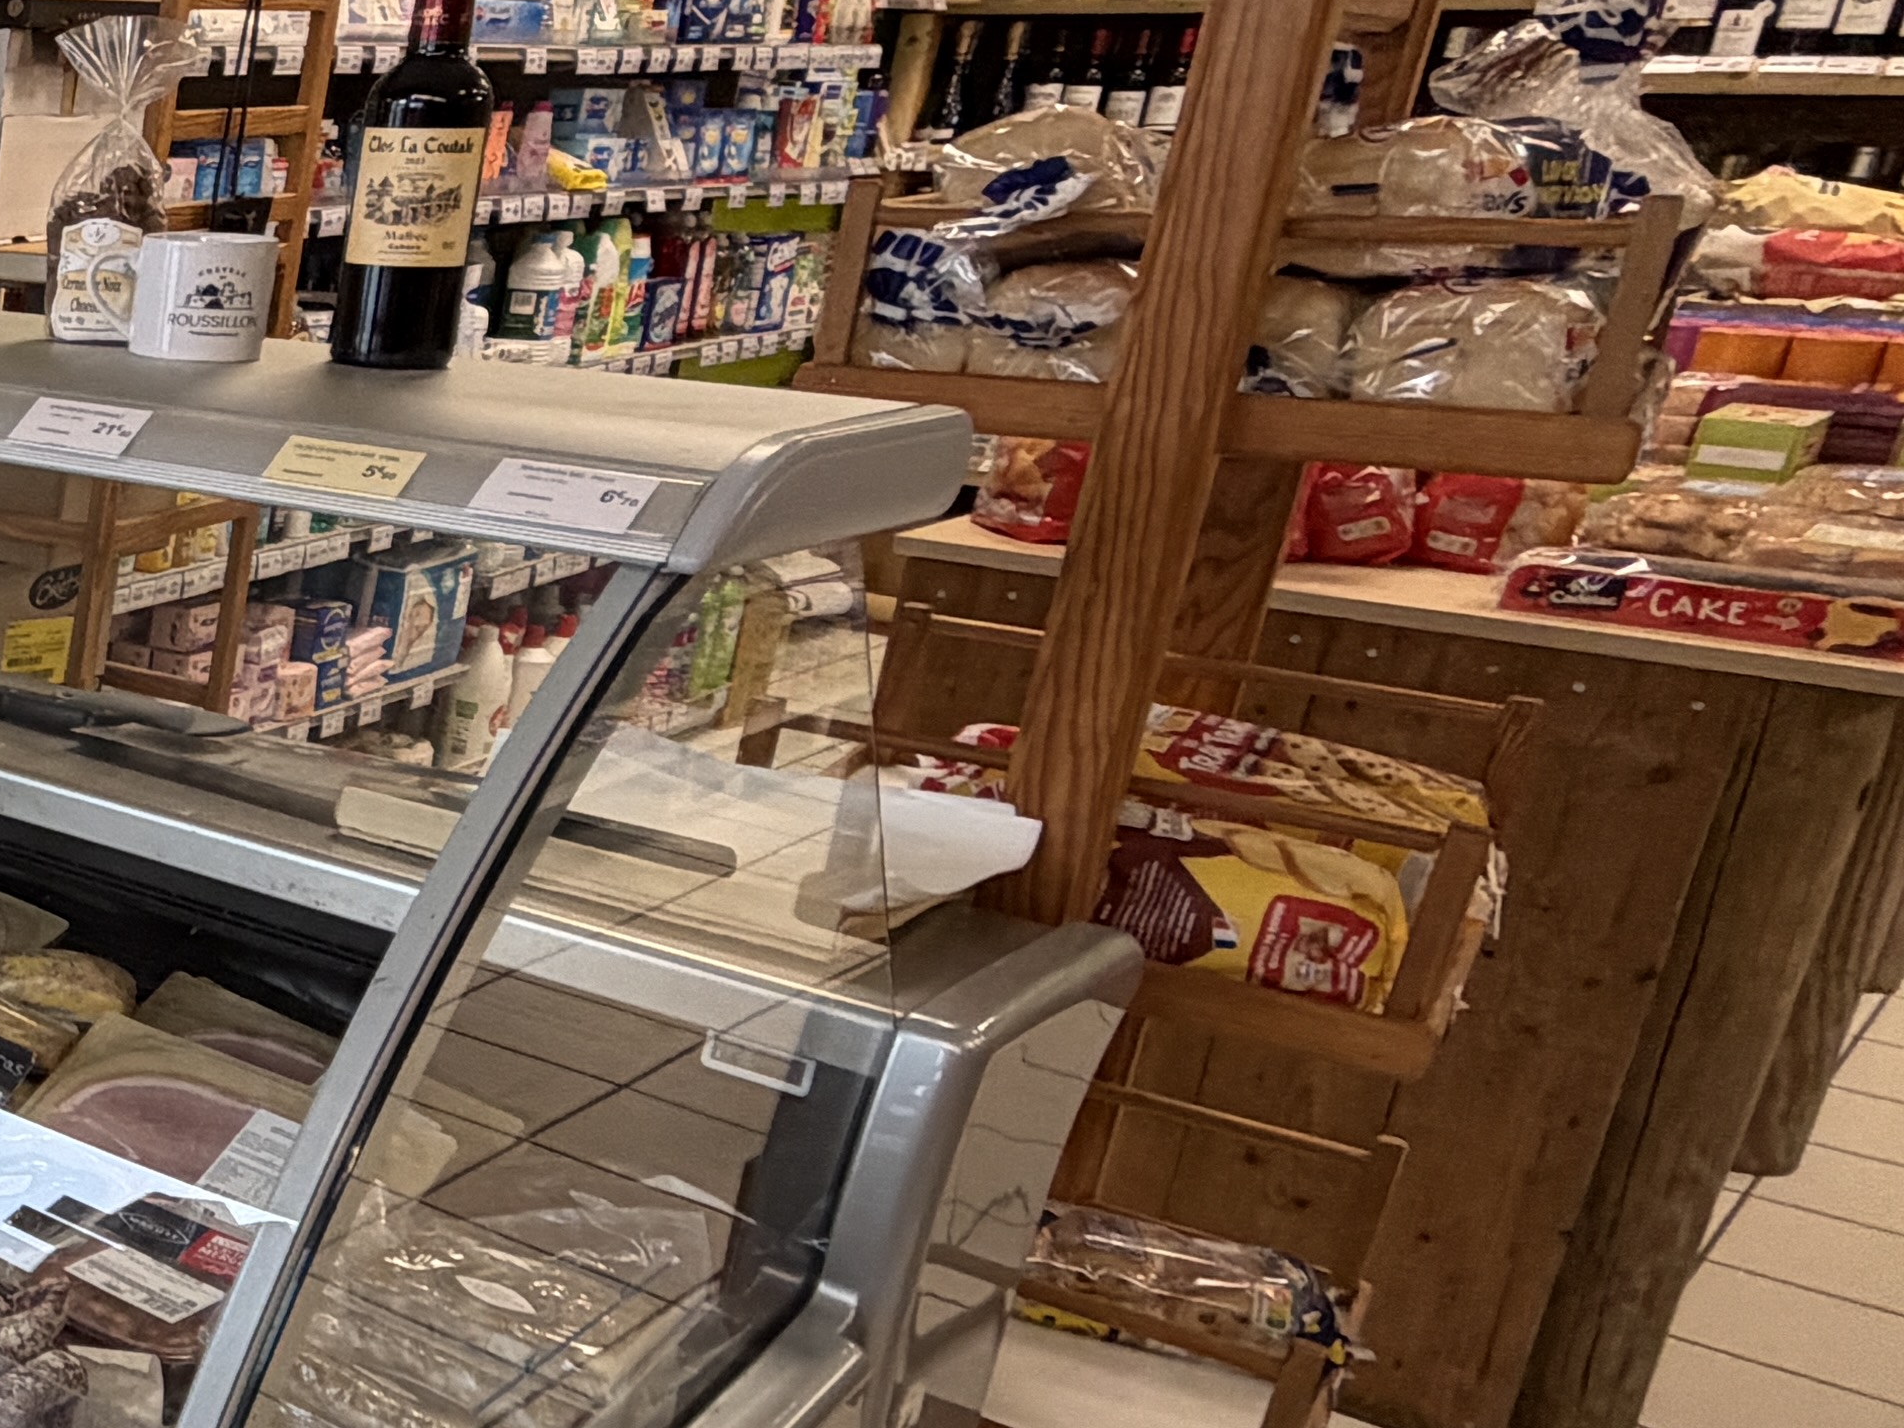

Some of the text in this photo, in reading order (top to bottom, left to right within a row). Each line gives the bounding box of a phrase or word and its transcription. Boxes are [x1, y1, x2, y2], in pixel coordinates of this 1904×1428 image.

[368, 135, 395, 153] Clos
[399, 135, 418, 154] La
[168, 312, 258, 328] ROUSSILLON
[1648, 587, 1749, 627] CAKE
